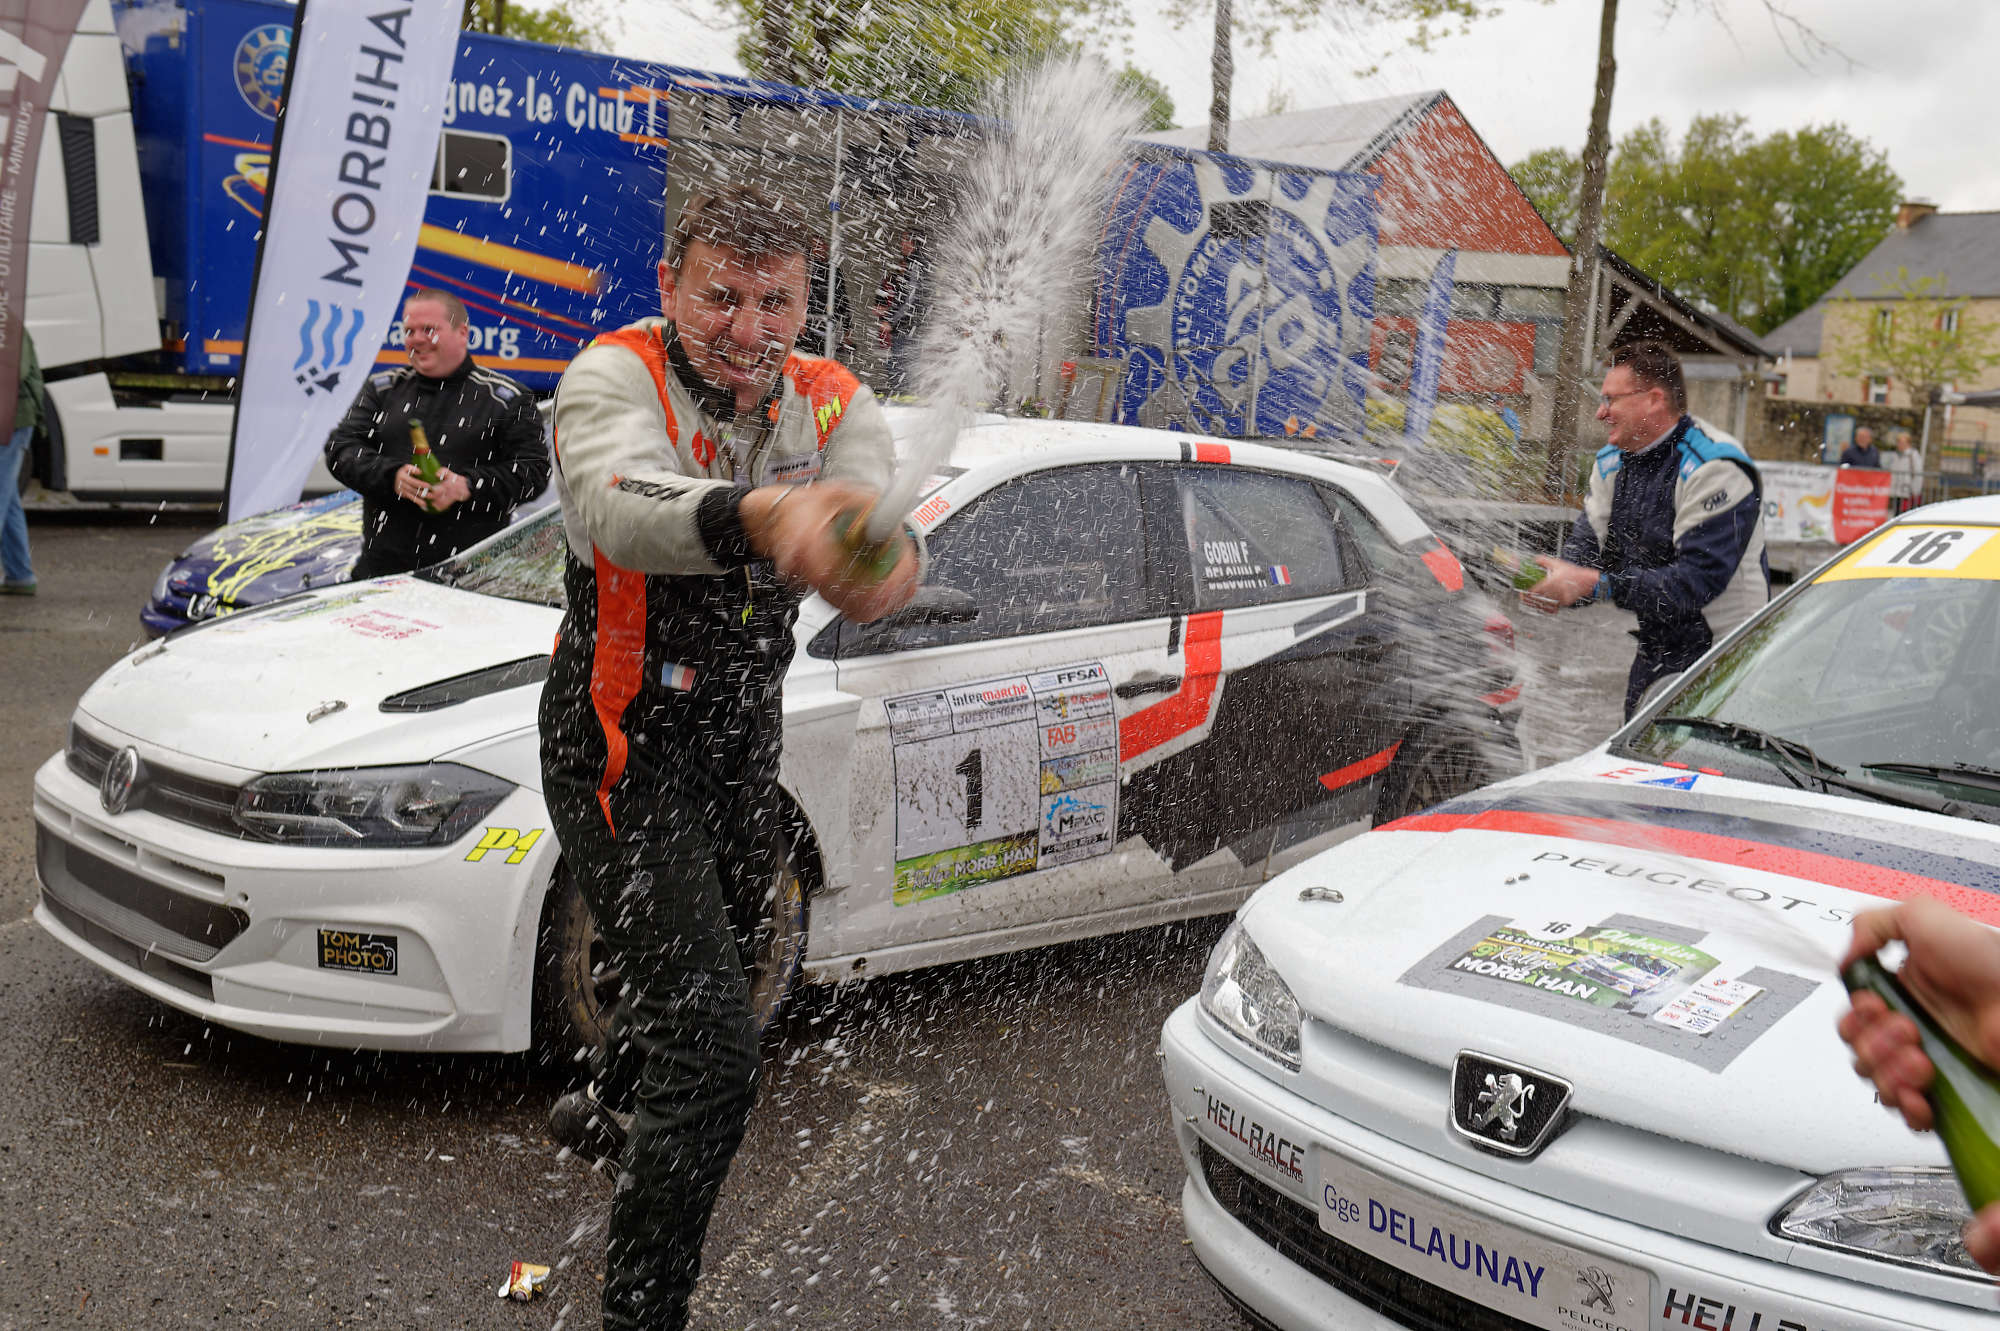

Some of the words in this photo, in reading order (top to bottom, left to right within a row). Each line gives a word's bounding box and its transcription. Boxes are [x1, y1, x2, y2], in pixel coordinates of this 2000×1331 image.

[526, 75, 554, 124] le
[565, 82, 634, 134] Club
[8, 101, 34, 175] MINIBUS
[320, 0, 414, 288] MORBIHA
[1703, 488, 1728, 512] OMP
[1203, 541, 1241, 565] GOBIN
[1240, 540, 1249, 564] F
[1887, 530, 1964, 565] 16
[1057, 667, 1098, 685] FFSA
[1047, 723, 1077, 749] FAB
[955, 748, 982, 829] 1
[464, 827, 545, 864] P1
[1531, 851, 1817, 911] PEUGEOT
[320, 930, 360, 949] TOM
[1521, 938, 1543, 948] MAI
[1542, 921, 1571, 934] 16
[324, 948, 385, 968] PHOTO
[1206, 1094, 1305, 1175] HELLRACE
[1249, 1146, 1304, 1184] SUSPENSIONS
[1324, 1184, 1360, 1223] Gge
[1368, 1198, 1545, 1298] DELAUNAY
[1558, 1306, 1633, 1331] PEUGEO
